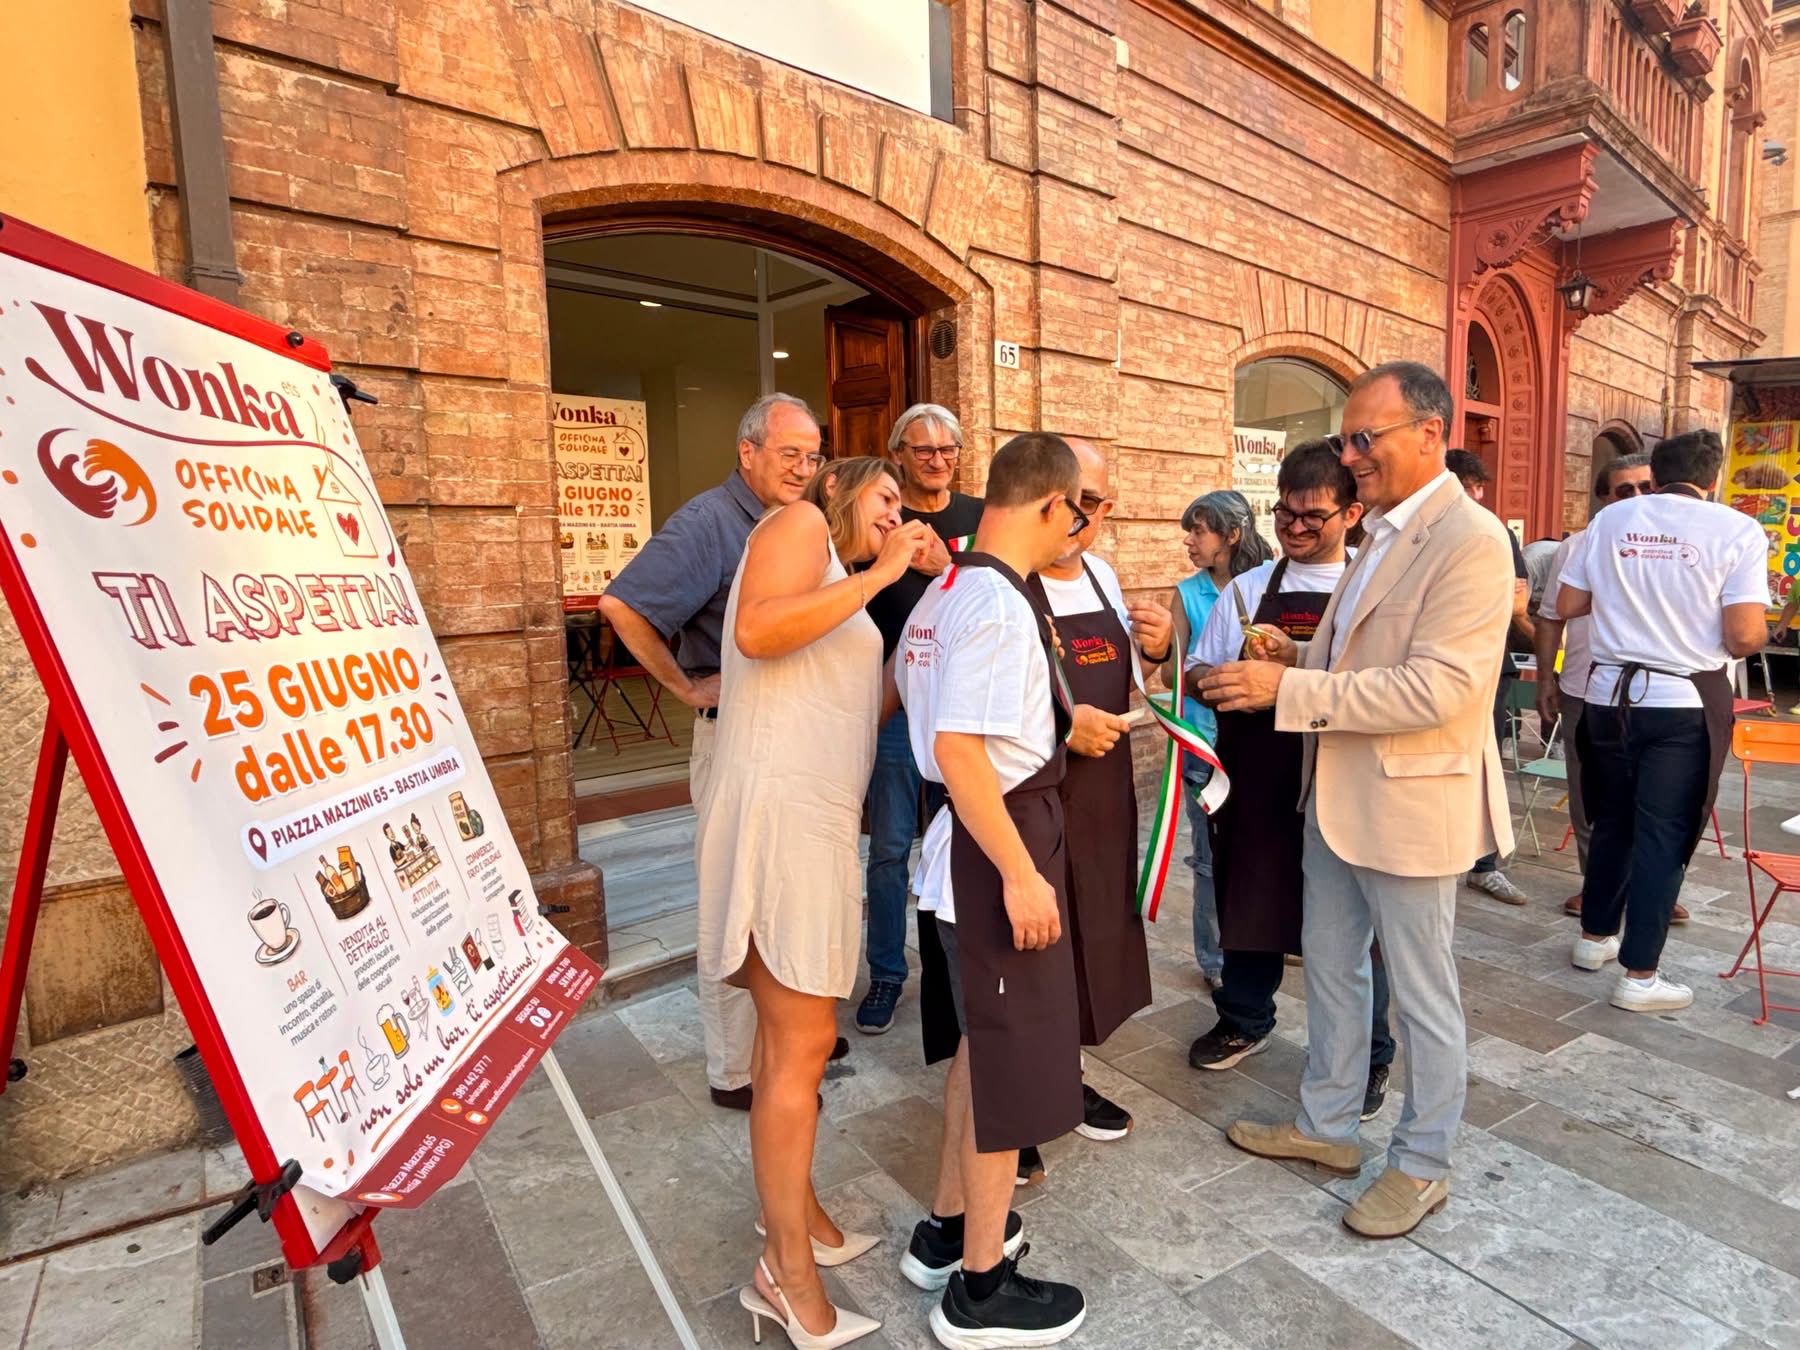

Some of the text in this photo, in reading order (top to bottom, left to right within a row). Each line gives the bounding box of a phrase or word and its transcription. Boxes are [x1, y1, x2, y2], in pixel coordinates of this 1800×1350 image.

[30, 300, 304, 439] Wonka
[1000, 344, 1016, 365] 65
[558, 443, 608, 454] SOLIDALE
[560, 432, 606, 444] OFFICINA
[1233, 434, 1277, 456] Wonka
[175, 458, 302, 503] OFFICINA
[565, 485, 633, 501] GIUGNO
[182, 499, 318, 539] SOLIDALE
[587, 504, 631, 518] 17.30
[1626, 533, 1677, 544] Wonka
[92, 570, 419, 651] TI ASPETTA!
[188, 647, 420, 737] 25 GIUGNO
[234, 701, 434, 802] dalle 17.30
[271, 813, 324, 848] PIAZZA
[323, 791, 374, 827] MAZZINI
[373, 785, 390, 804] 65
[395, 771, 430, 795] BASTIA
[428, 757, 461, 781] UMBRA
[339, 914, 388, 953] VENDITA AL
[346, 928, 390, 966] DETTAGLIO
[284, 977, 322, 1015] uno spazio di
[286, 969, 309, 993] BAR
[279, 1010, 312, 1036] incontro,
[290, 1021, 316, 1047] musica
[319, 1003, 338, 1024] ristoro
[360, 942, 537, 1135] non solo un bar, ti aspettiamo!
[452, 1080, 469, 1099] 389
[464, 1069, 482, 1087] 442
[418, 1154, 441, 1178] Umbra
[437, 1138, 456, 1158] (PG)
